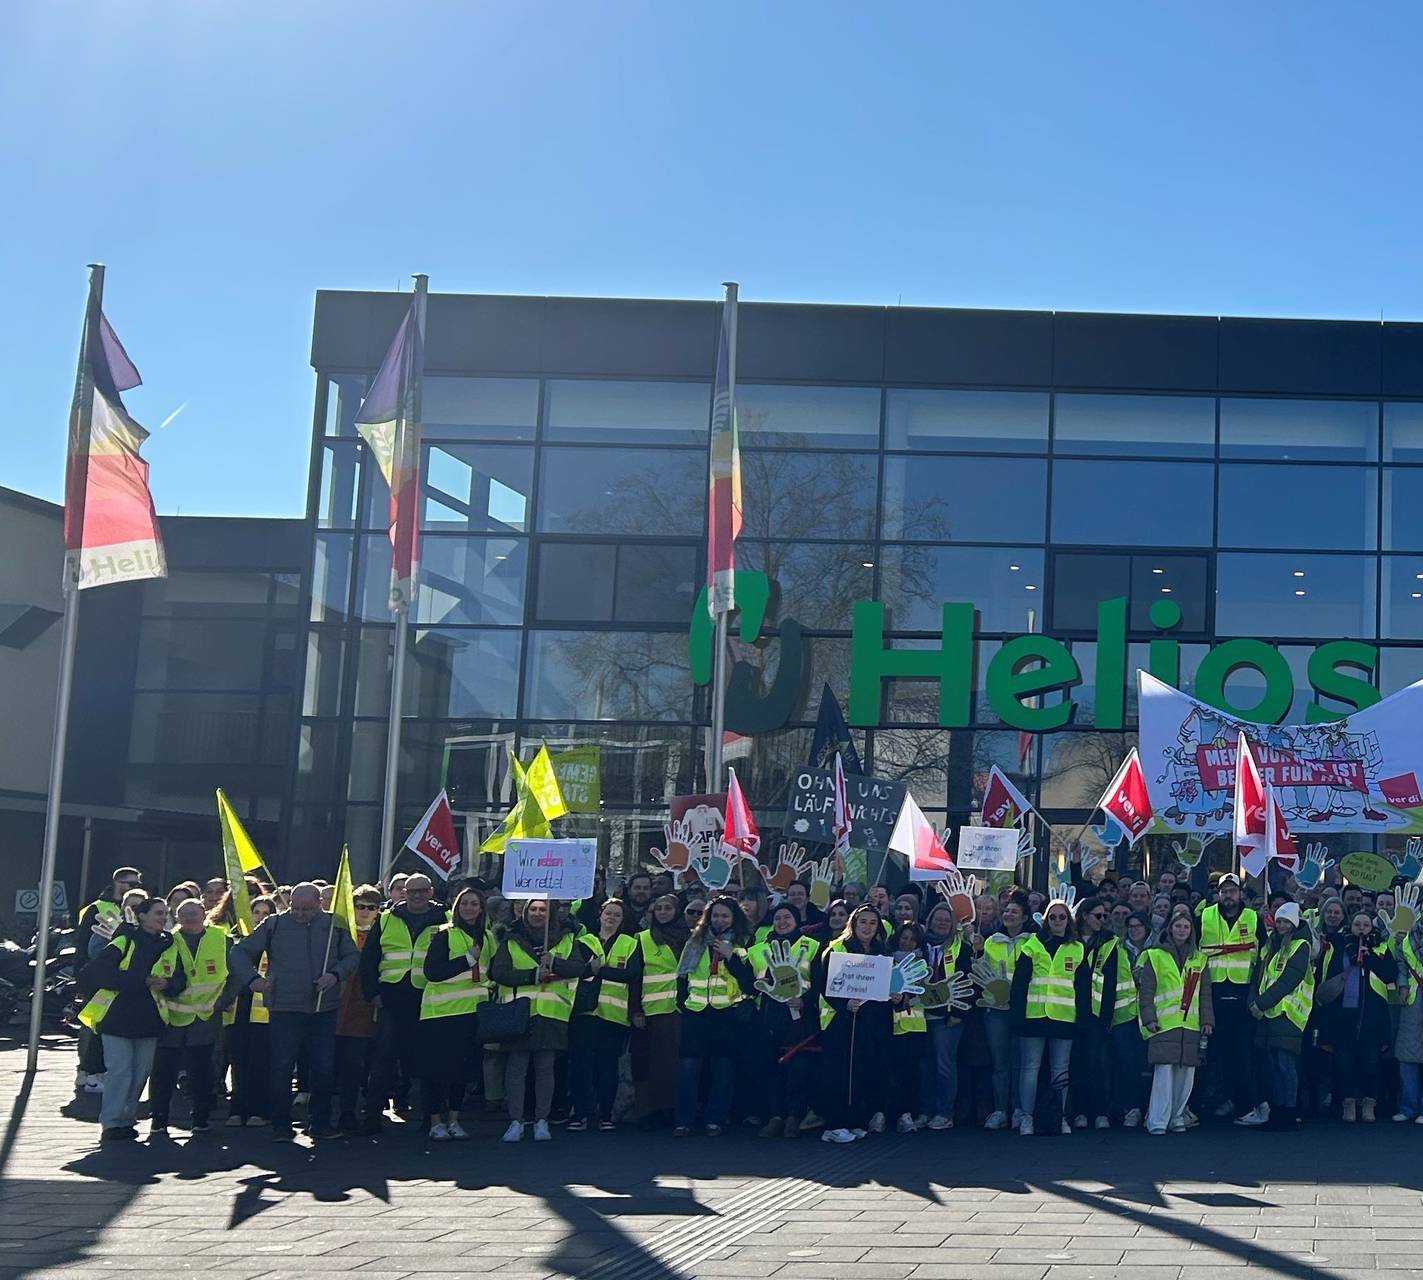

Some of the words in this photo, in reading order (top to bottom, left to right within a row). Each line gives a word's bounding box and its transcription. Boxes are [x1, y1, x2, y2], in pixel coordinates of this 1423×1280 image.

[89, 549, 159, 579] Heli
[848, 597, 1380, 731] Helios
[1216, 766, 1276, 787] BEER
[858, 782, 894, 800] UNS
[794, 793, 840, 814] LÄUF
[518, 847, 535, 867] Wir
[513, 867, 533, 889] Wer
[535, 867, 564, 890] rettet
